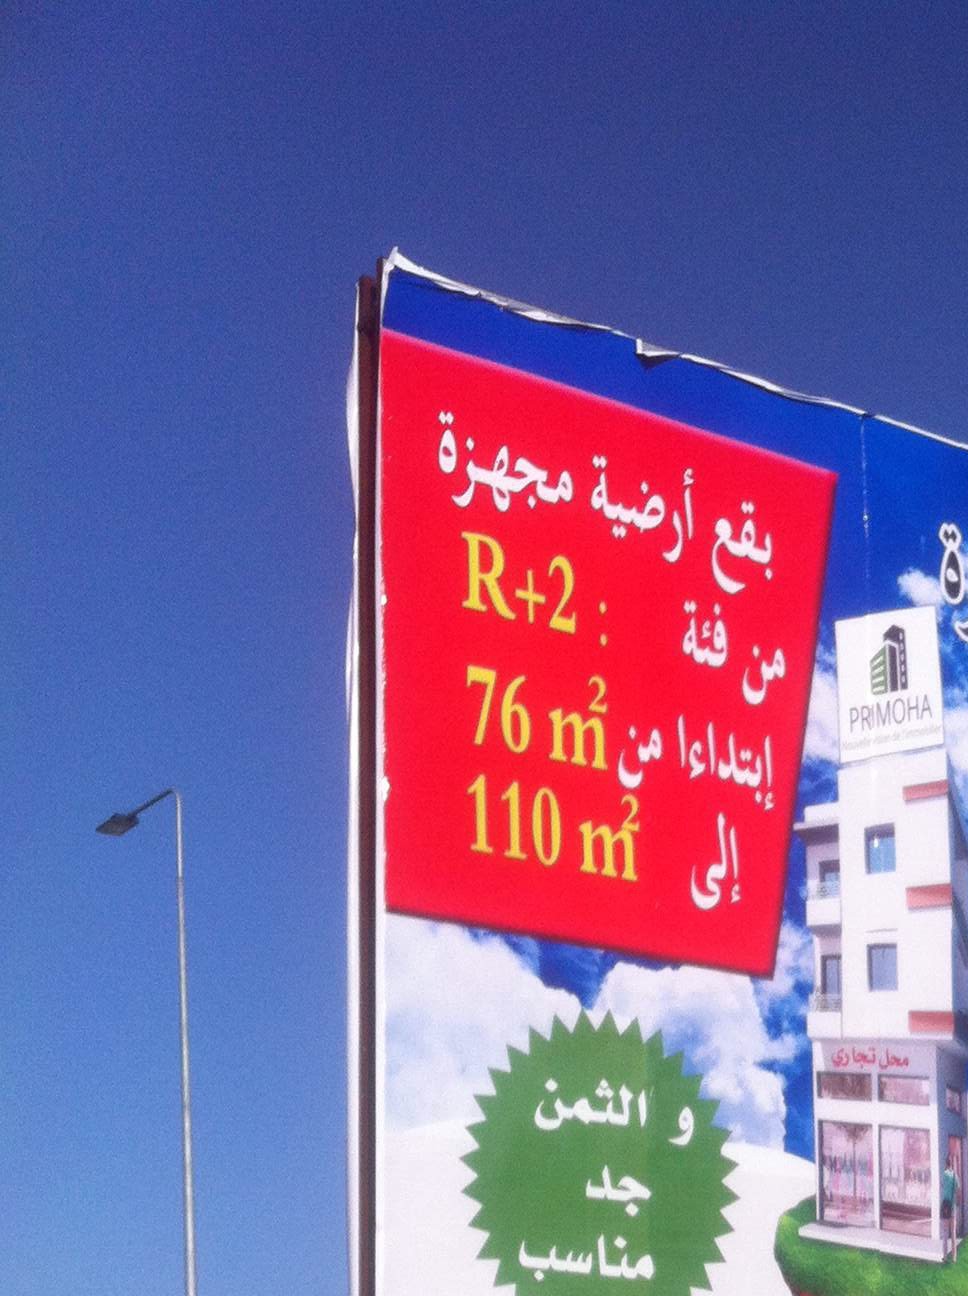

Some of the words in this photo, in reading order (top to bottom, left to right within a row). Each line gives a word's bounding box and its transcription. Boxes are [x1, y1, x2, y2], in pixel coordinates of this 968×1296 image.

[437, 411, 573, 513] مجهزة
[590, 455, 696, 563] أرضية
[712, 502, 775, 595] بقع
[460, 530, 577, 635] R+2
[682, 599, 729, 668] فئة
[743, 644, 787, 705] من
[465, 663, 530, 755] 76
[849, 694, 933, 733] PRIMOHA
[617, 724, 663, 788] من
[466, 773, 561, 867] 110
[690, 812, 742, 910] إلى
[878, 1047, 909, 1070] محل
[534, 1078, 649, 1131] الثمن
[668, 1106, 695, 1146] و
[586, 1164, 652, 1217] جد
[518, 1233, 655, 1283] مناسب
